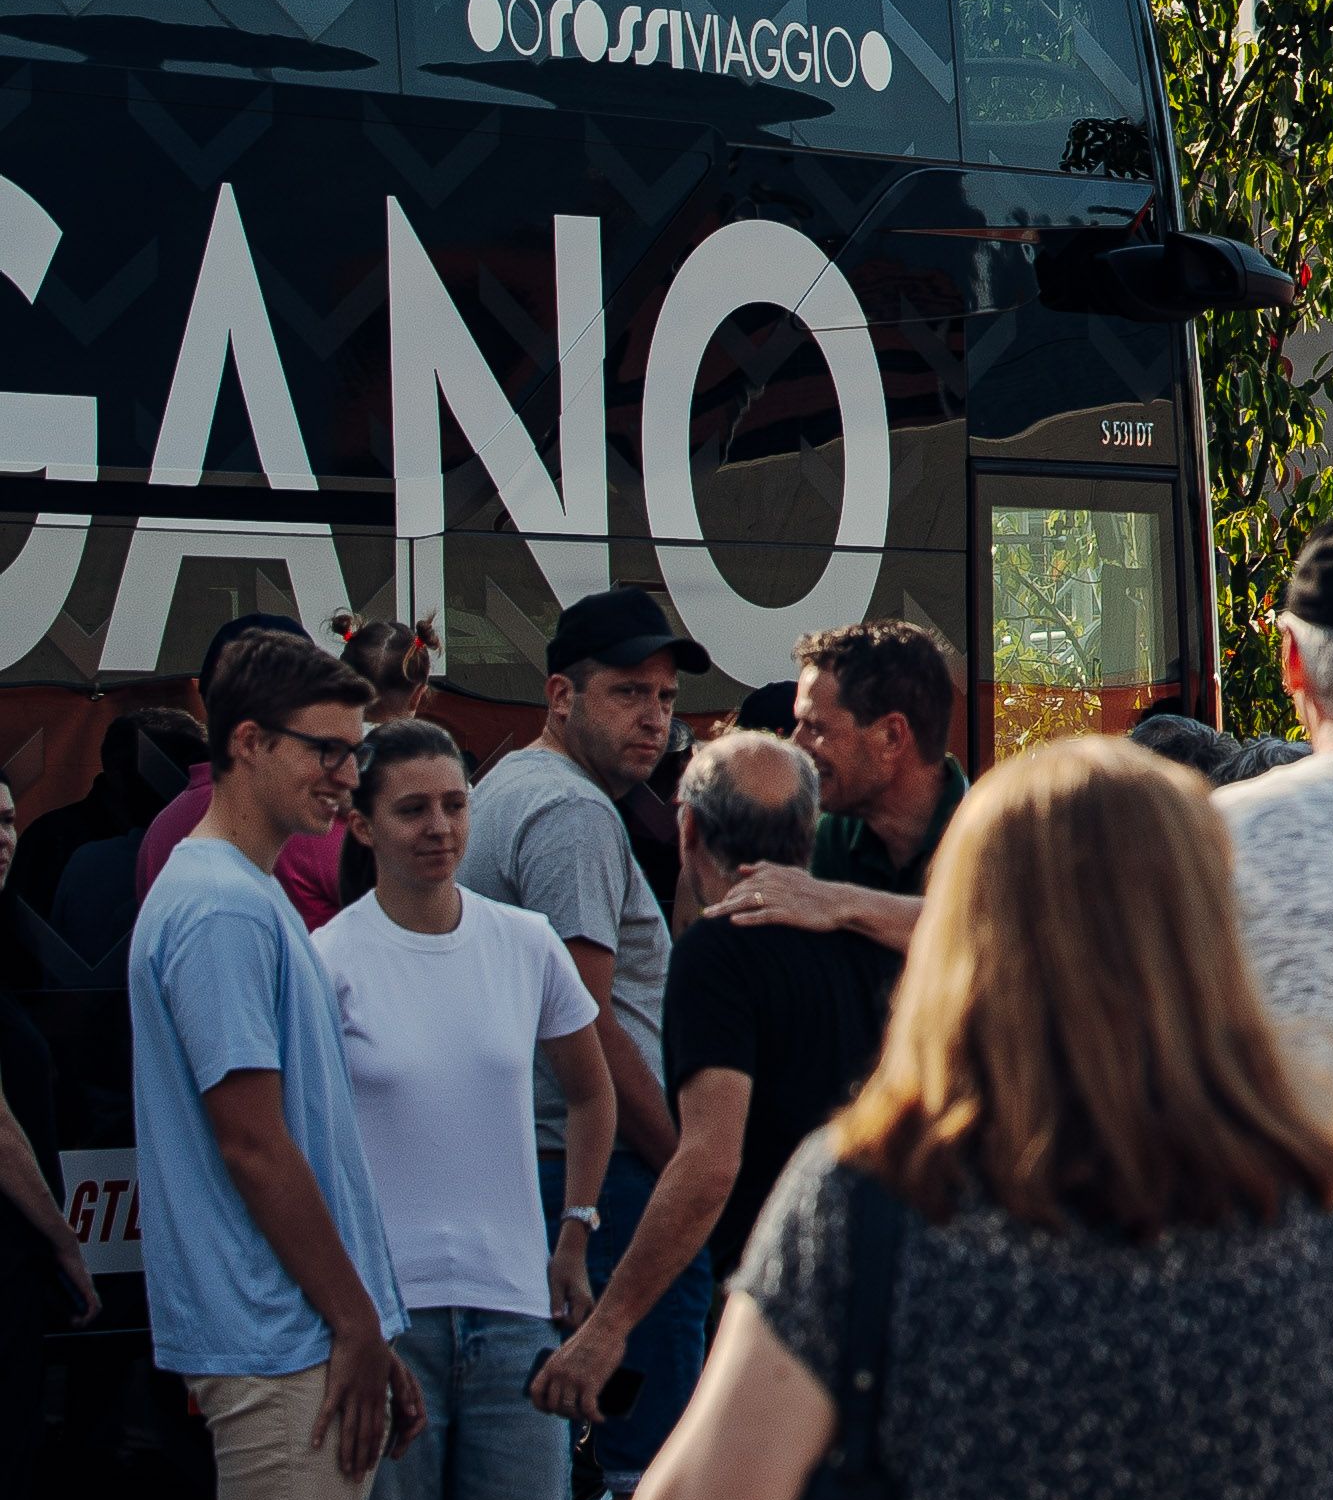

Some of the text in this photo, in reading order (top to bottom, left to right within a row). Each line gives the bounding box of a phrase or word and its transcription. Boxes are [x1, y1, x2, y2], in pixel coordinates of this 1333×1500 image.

[1101, 420, 1154, 447] S 531 DT
